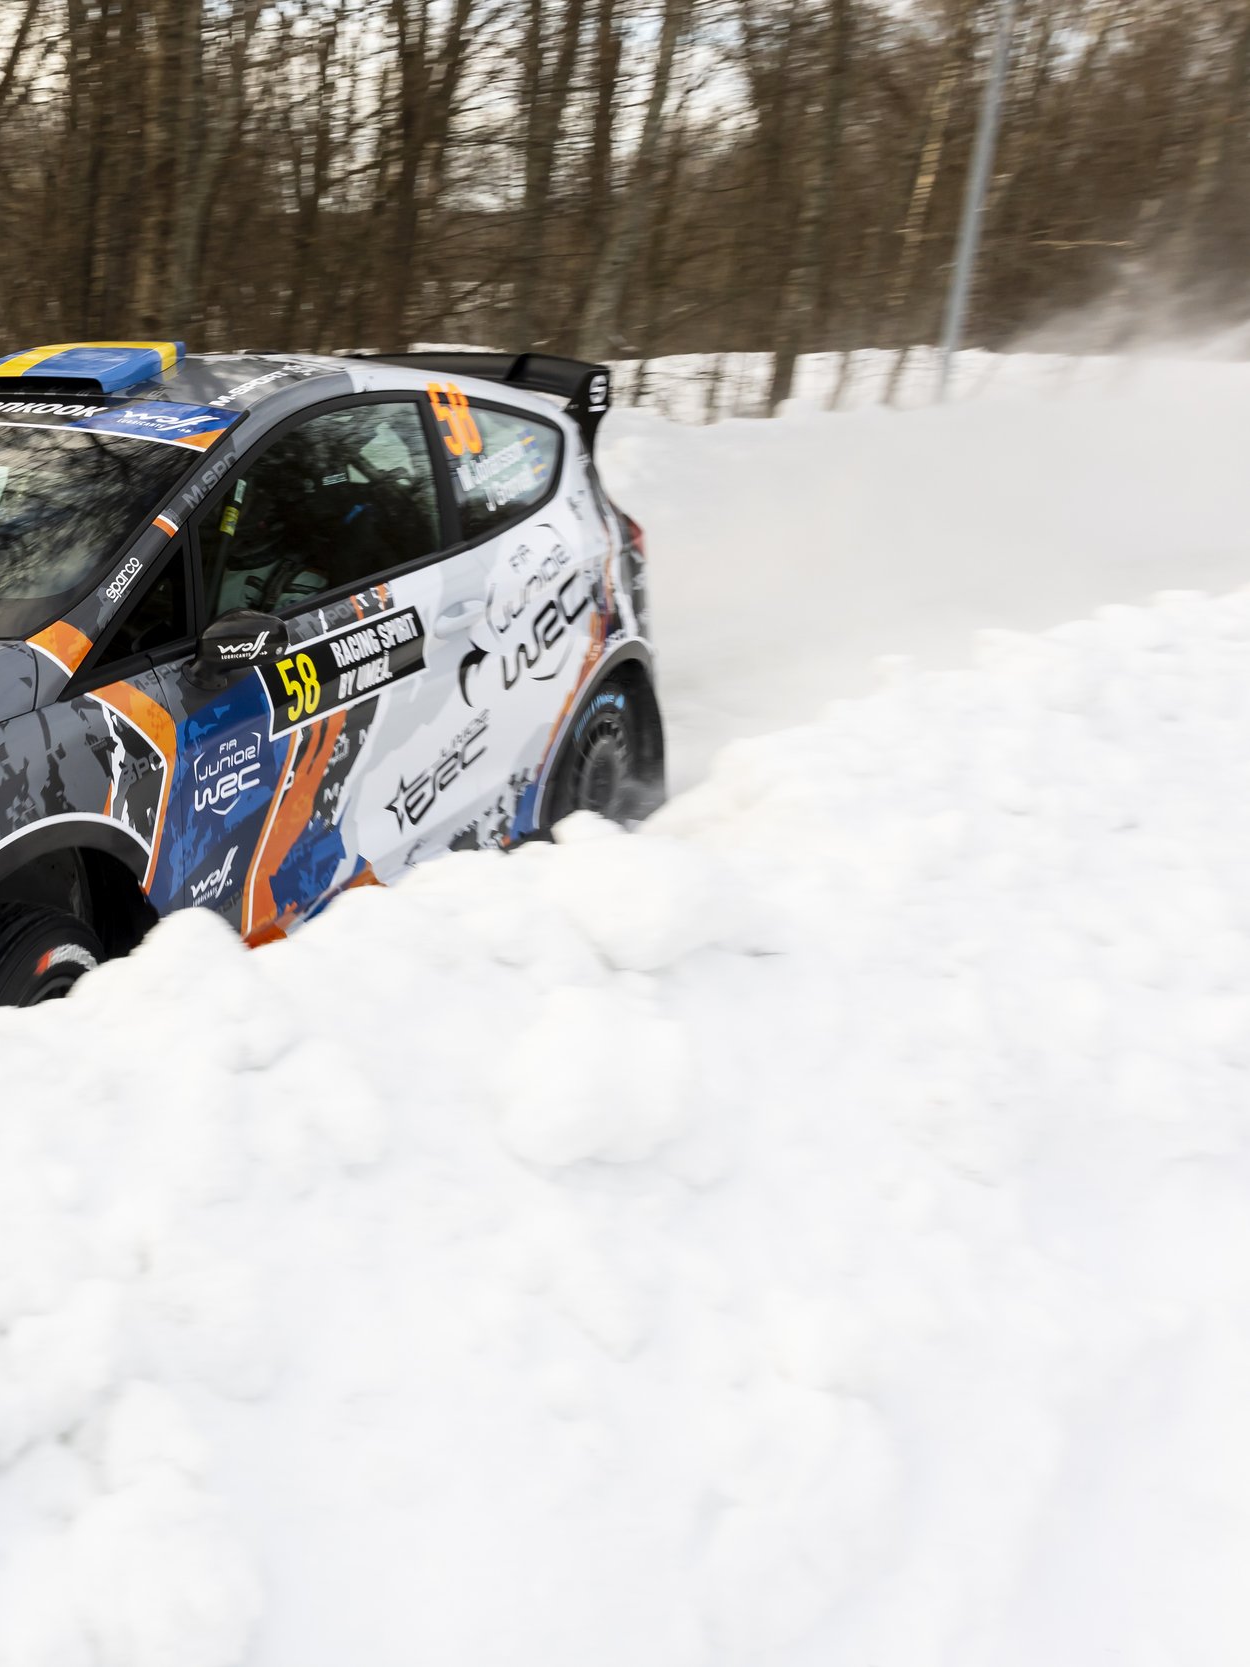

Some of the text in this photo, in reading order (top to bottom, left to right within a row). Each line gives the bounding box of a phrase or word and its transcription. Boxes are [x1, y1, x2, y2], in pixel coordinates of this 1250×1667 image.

[427, 382, 483, 457] 58
[329, 612, 419, 668] RACING SPIRIT
[501, 567, 590, 691] WRC
[276, 653, 321, 722] 58
[338, 668, 358, 700] BY
[197, 745, 258, 783] JUNIOR
[219, 738, 238, 755] FIA
[193, 761, 262, 813] WRC
